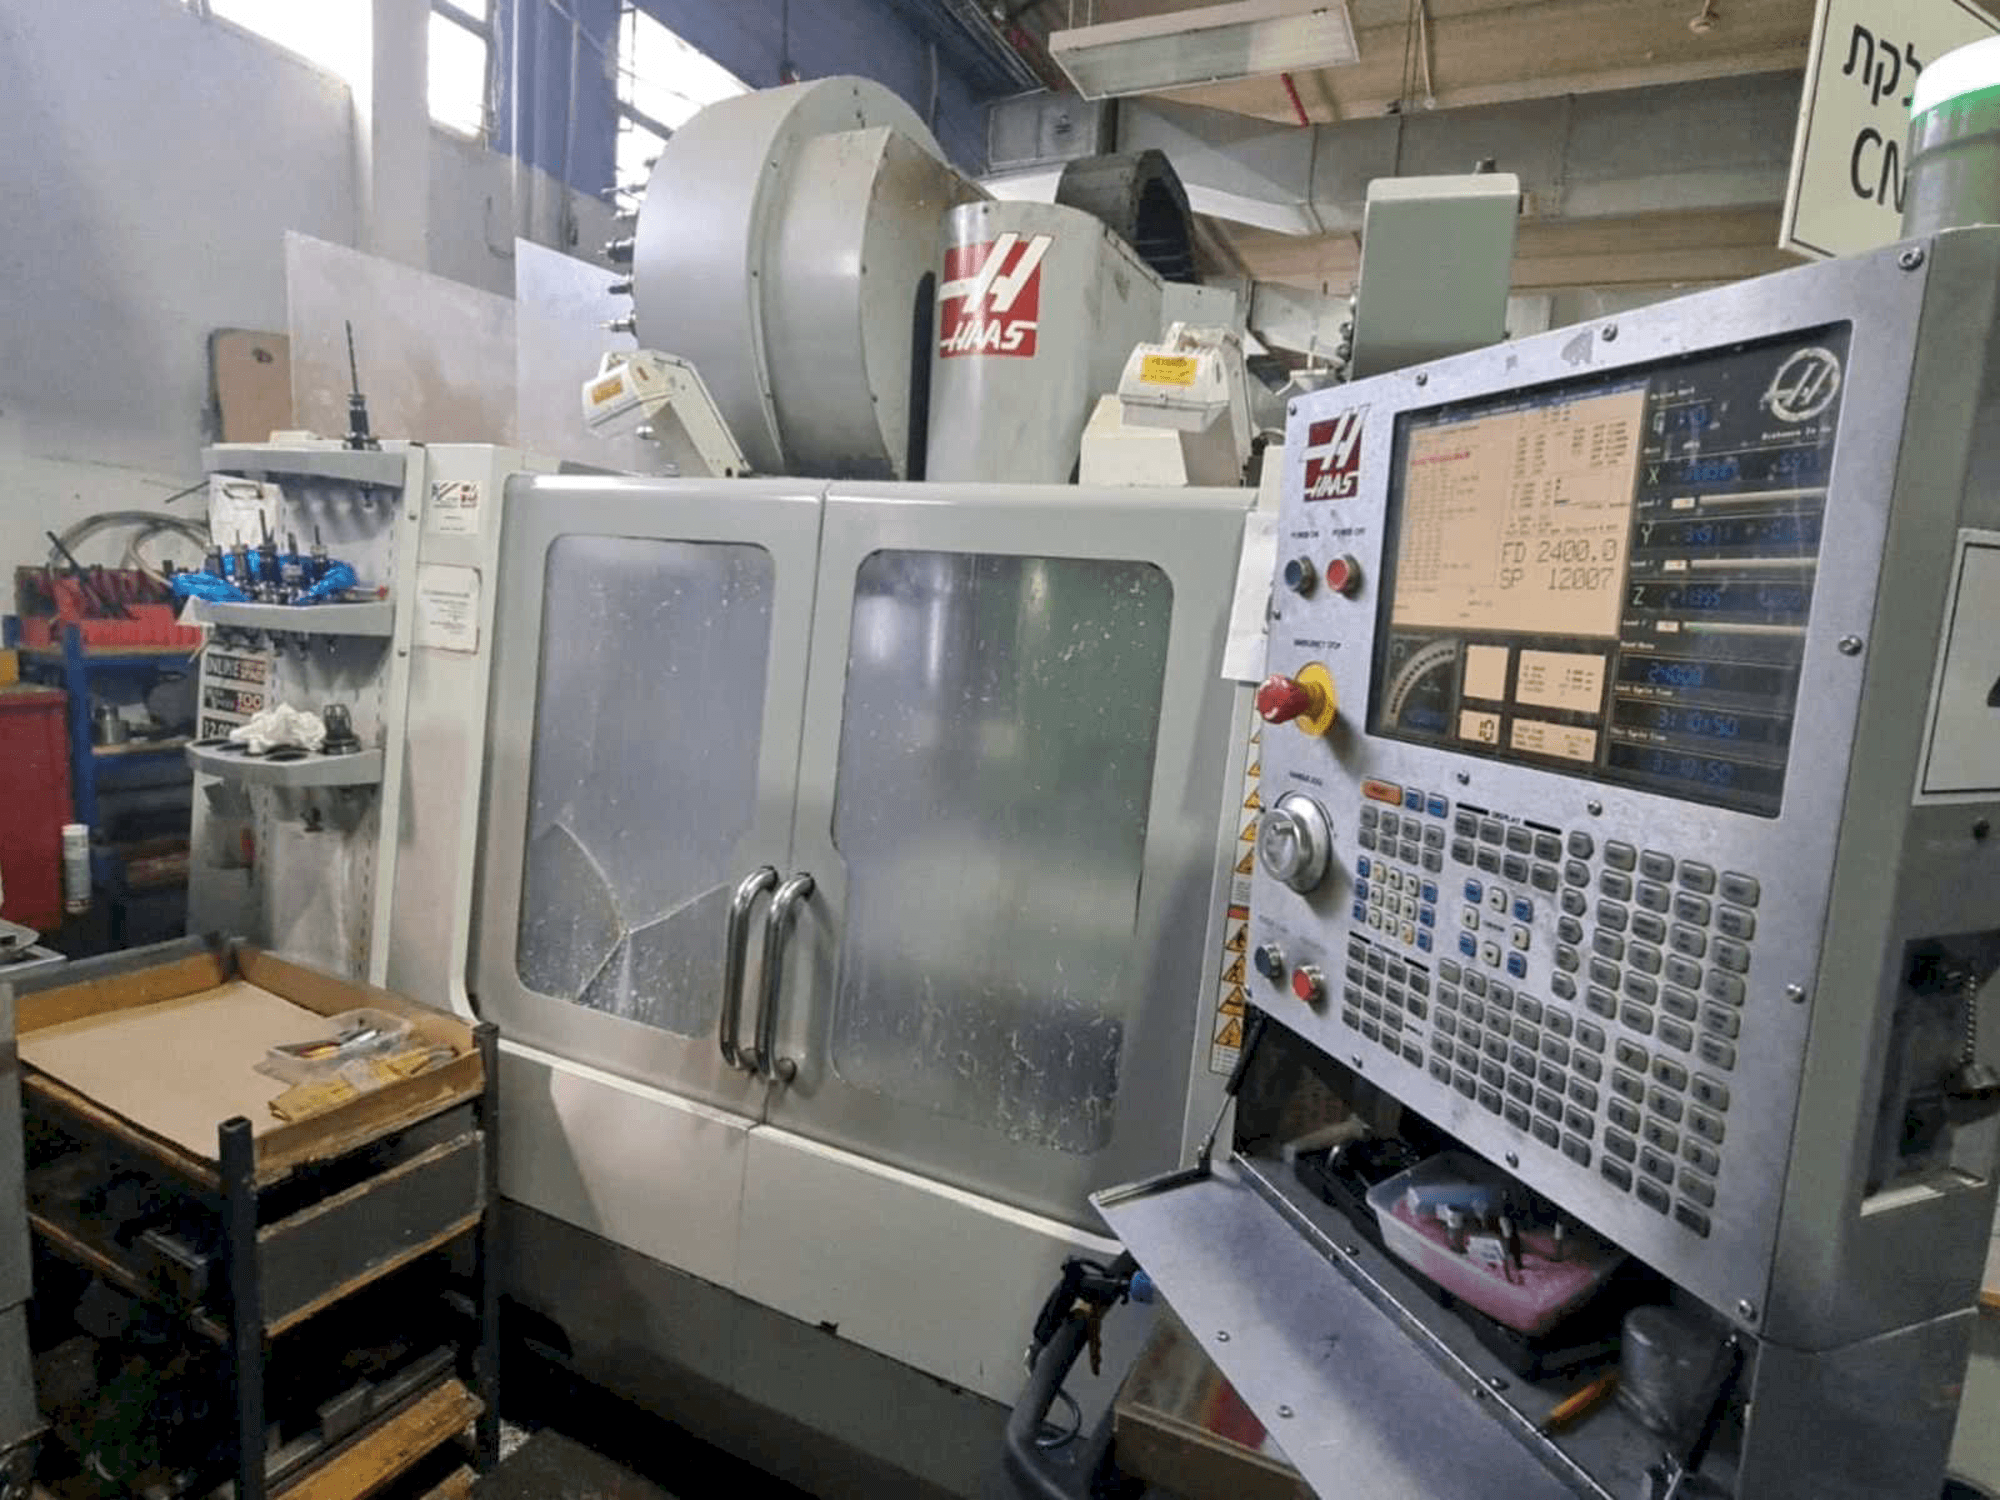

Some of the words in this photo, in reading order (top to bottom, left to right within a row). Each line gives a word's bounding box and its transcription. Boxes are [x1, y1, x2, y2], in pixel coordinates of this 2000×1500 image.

[939, 319, 1038, 352] HAAS
[1305, 471, 1360, 498] HAAS
[1648, 466, 1660, 484] X
[1640, 524, 1653, 546] Y
[1501, 541, 1526, 564] FD
[1500, 568, 1524, 590] SP
[1631, 586, 1646, 606] Z
